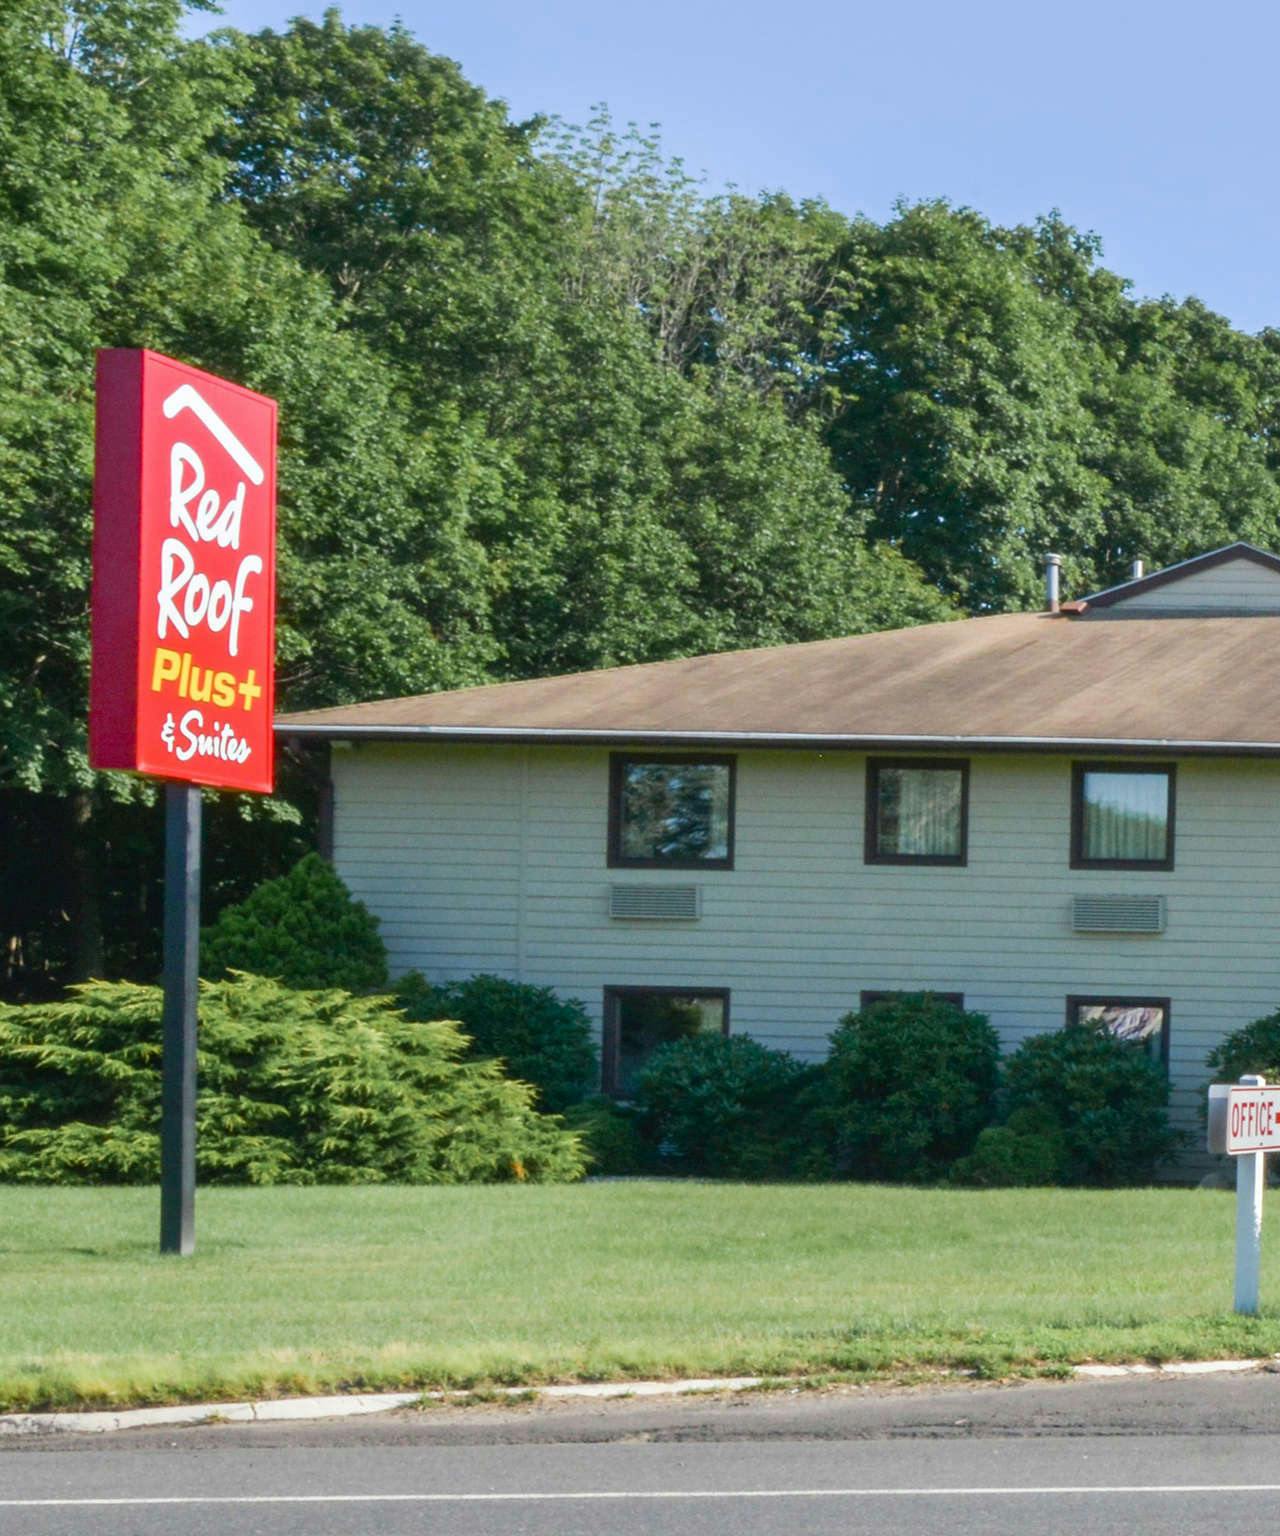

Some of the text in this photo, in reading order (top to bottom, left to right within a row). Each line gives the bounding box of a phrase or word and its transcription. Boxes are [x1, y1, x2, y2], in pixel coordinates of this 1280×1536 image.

[170, 441, 246, 550] Red
[157, 537, 263, 656] Roof
[160, 709, 252, 765] & Suites
[1231, 1101, 1274, 1138] OFFICE
